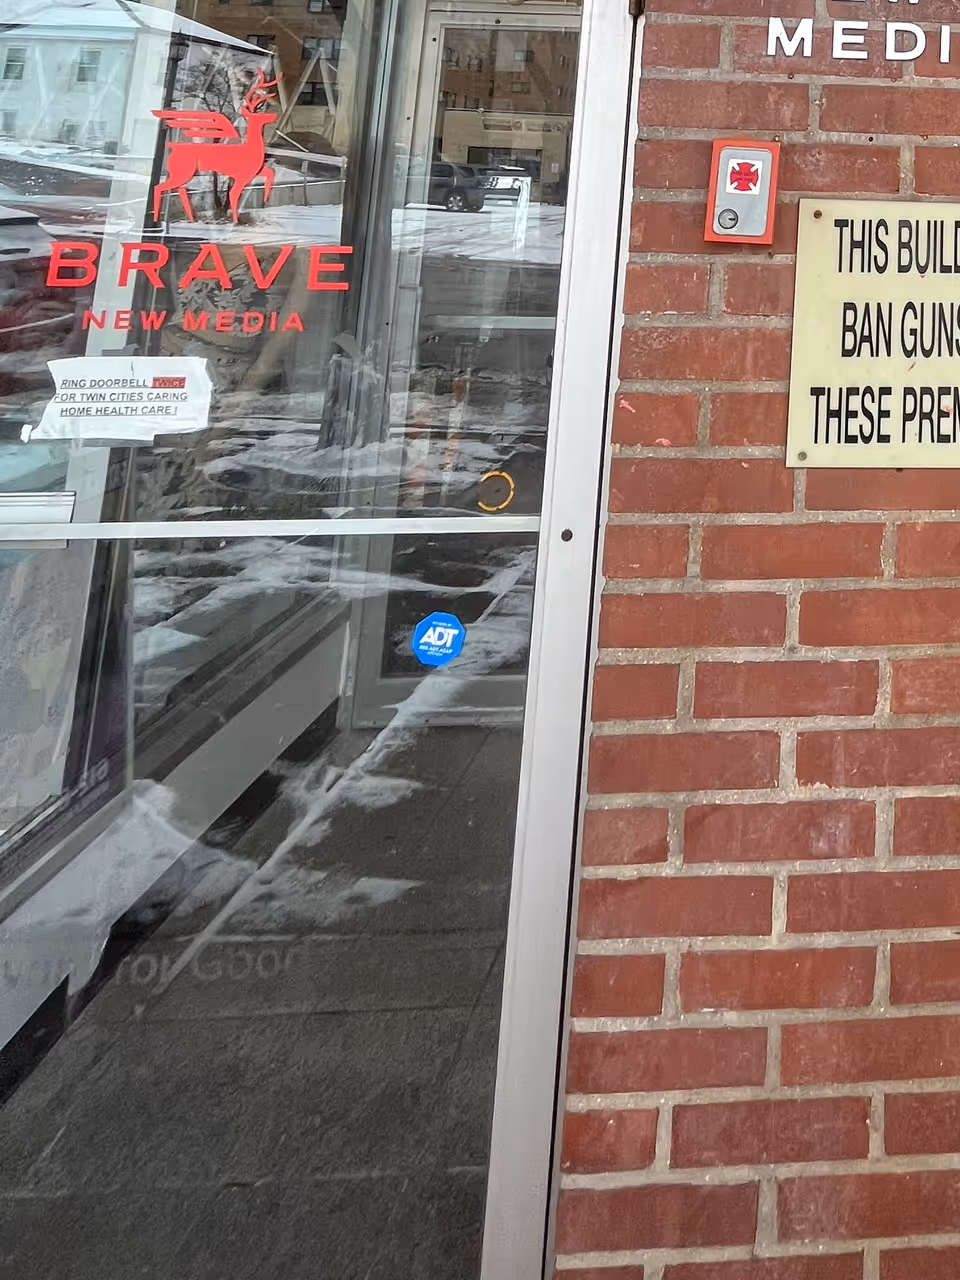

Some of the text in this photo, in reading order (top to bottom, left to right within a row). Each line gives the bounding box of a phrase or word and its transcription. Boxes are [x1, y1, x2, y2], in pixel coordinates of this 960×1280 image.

[833, 218, 889, 275] THIS
[44, 240, 354, 291] BRAVE
[81, 309, 305, 332] NEW MEDIA
[840, 301, 893, 359] BAN
[60, 377, 186, 388] RING DOORBELL TWICE
[80, 392, 107, 402] TWIN
[109, 392, 144, 402] CITIES
[144, 391, 188, 401] CARING
[60, 407, 92, 416] HOME
[95, 406, 139, 416] HEALTH
[140, 405, 172, 415] CARE
[809, 385, 892, 445] THESE
[419, 626, 459, 648] ADT
